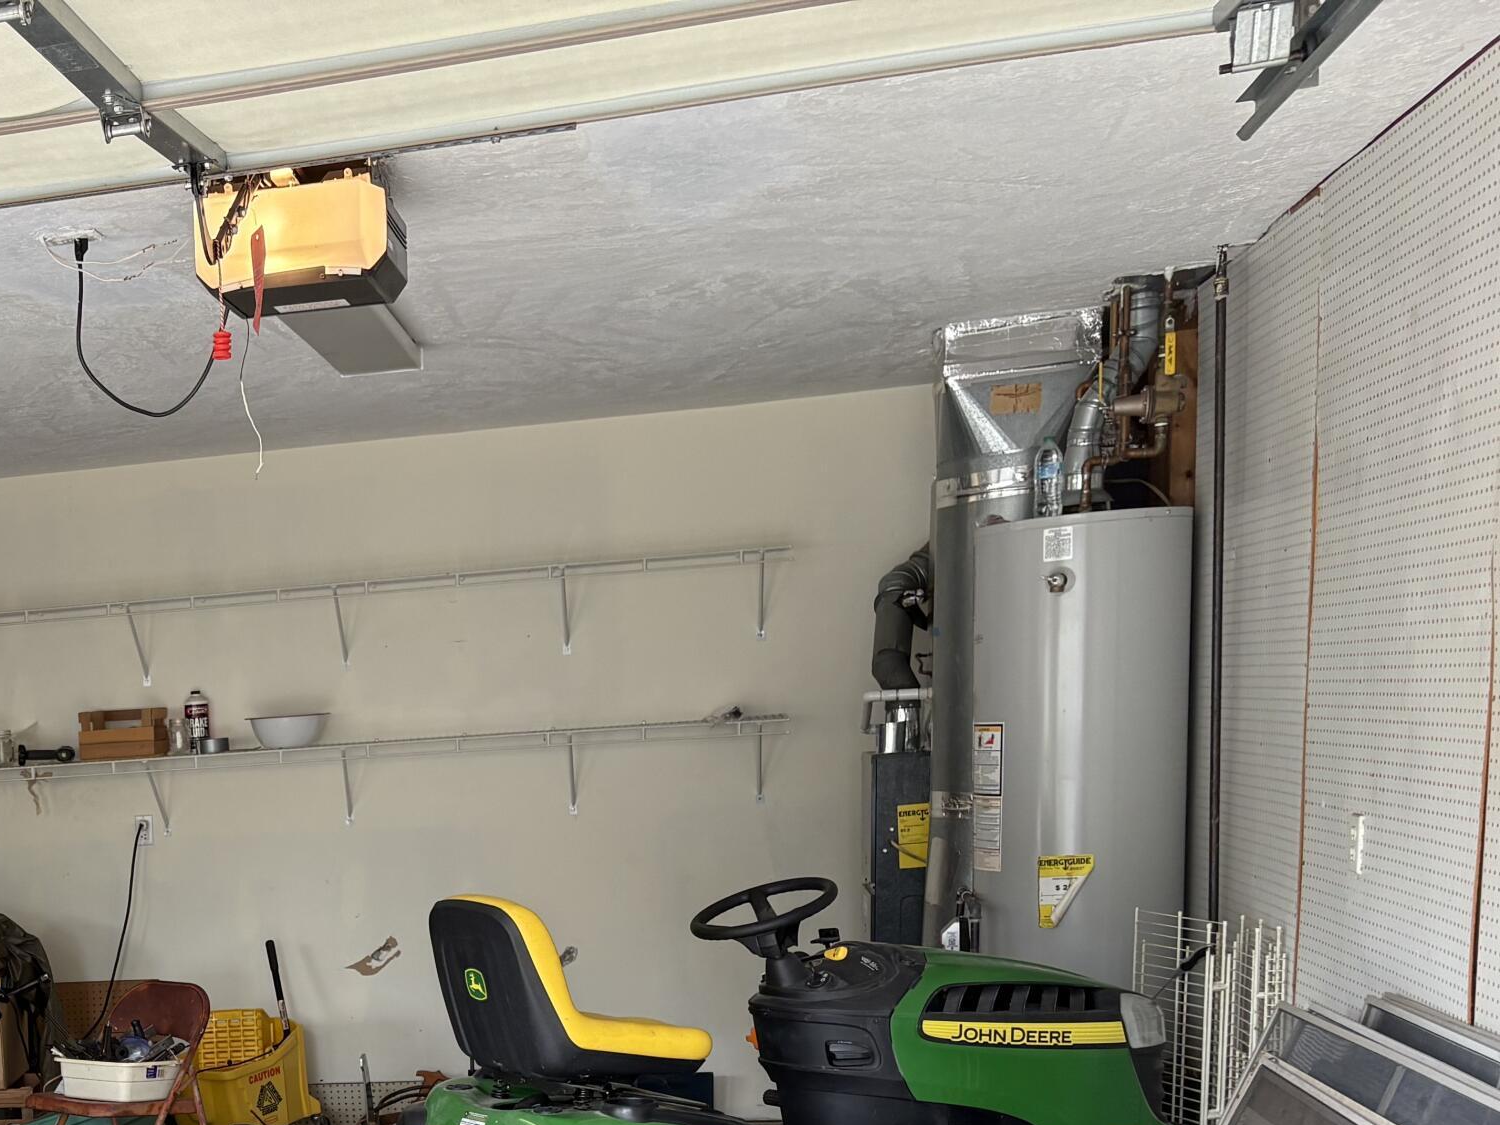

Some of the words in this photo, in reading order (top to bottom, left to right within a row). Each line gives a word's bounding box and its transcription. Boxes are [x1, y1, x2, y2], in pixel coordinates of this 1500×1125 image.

[951, 1023, 1007, 1043] JOHN
[1011, 1027, 1073, 1044] DEERE
[249, 1065, 281, 1085] CAUTION
